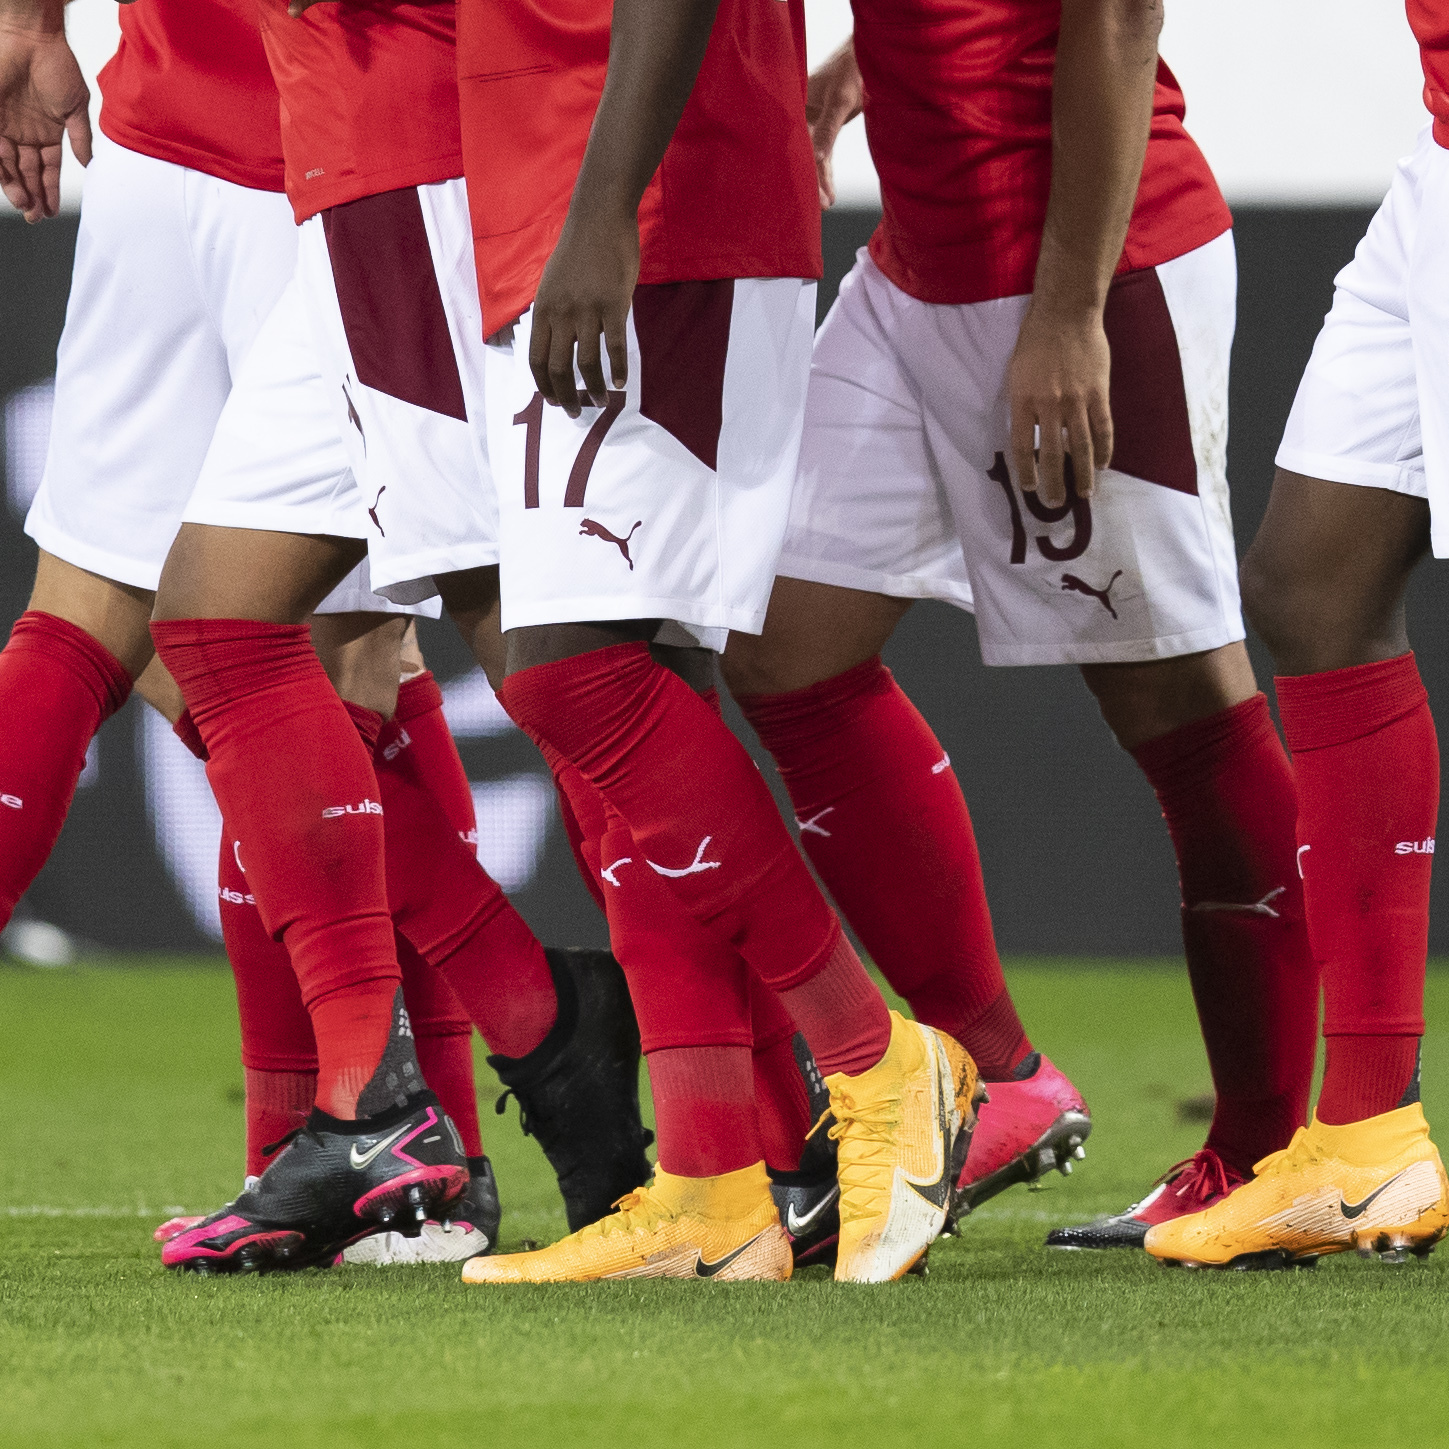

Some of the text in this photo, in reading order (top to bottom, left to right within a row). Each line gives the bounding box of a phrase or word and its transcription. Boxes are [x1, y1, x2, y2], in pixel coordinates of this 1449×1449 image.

[512, 389, 627, 509] 17
[985, 450, 1092, 564] 19
[322, 798, 383, 819] suis
